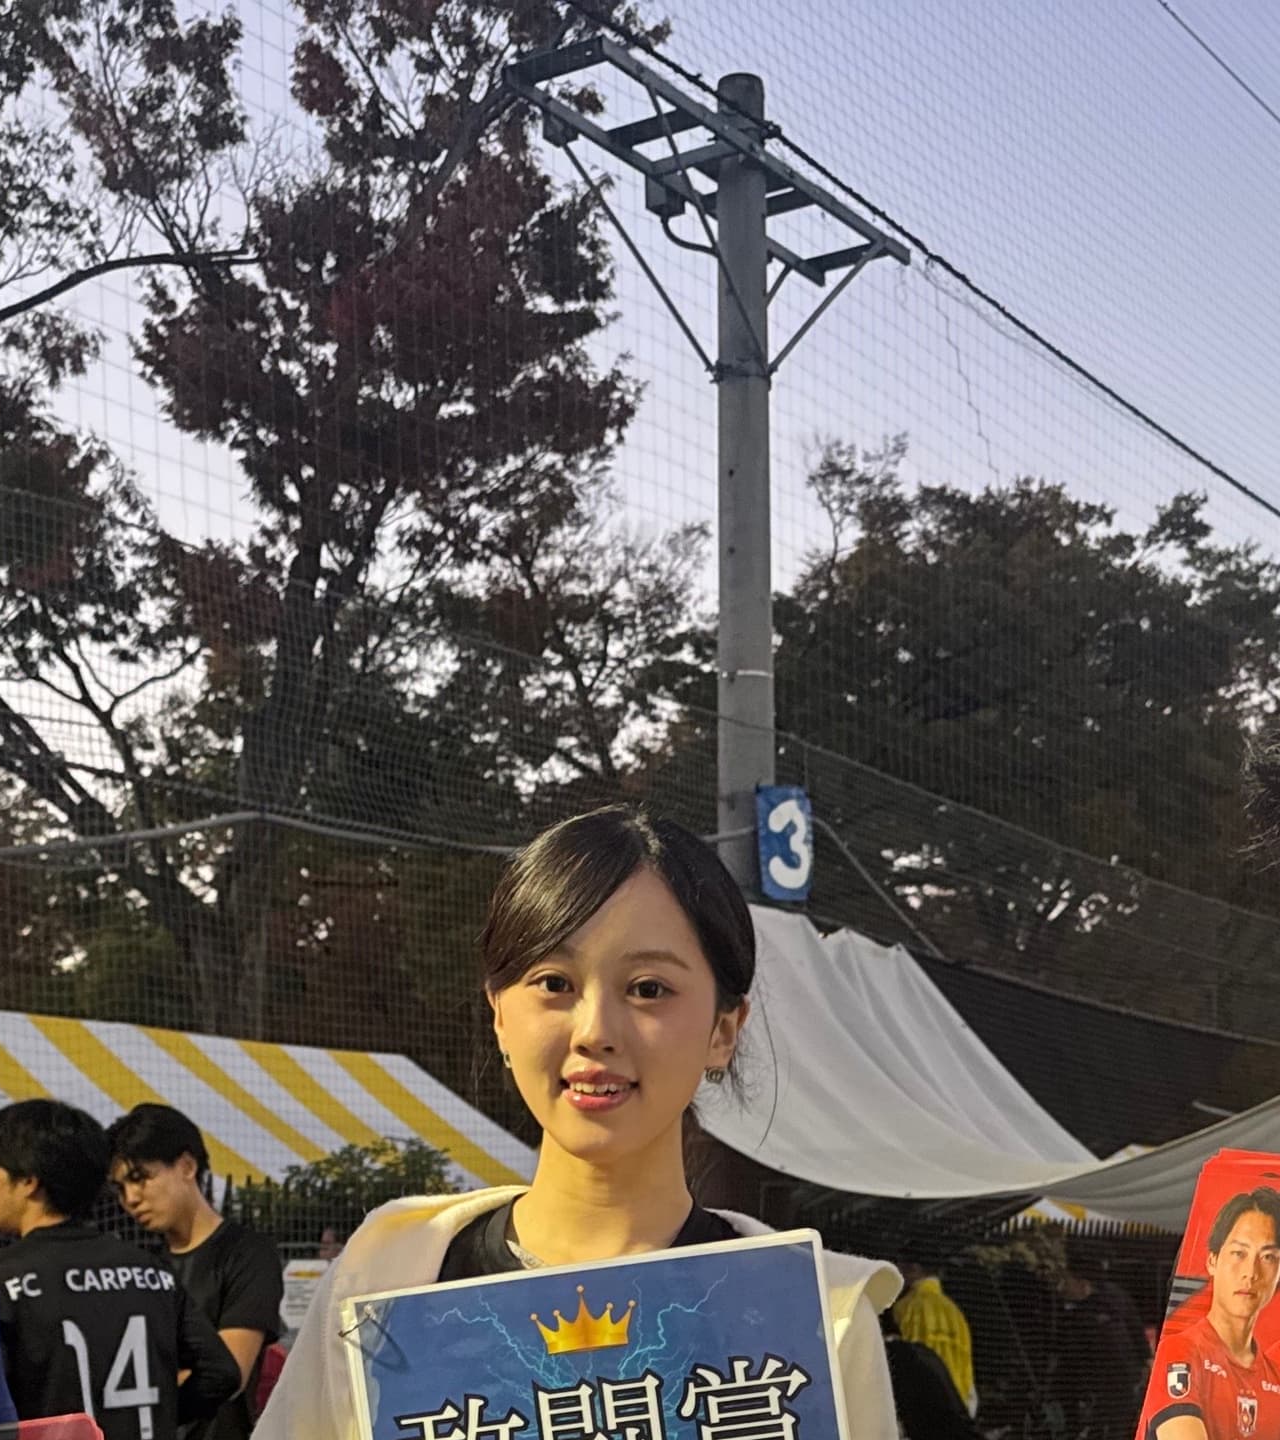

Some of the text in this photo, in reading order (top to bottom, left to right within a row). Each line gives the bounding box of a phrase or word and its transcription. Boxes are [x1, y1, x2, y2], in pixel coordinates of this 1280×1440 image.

[767, 798, 811, 889] 3
[4, 1272, 42, 1301] FC
[62, 1315, 160, 1440] 14
